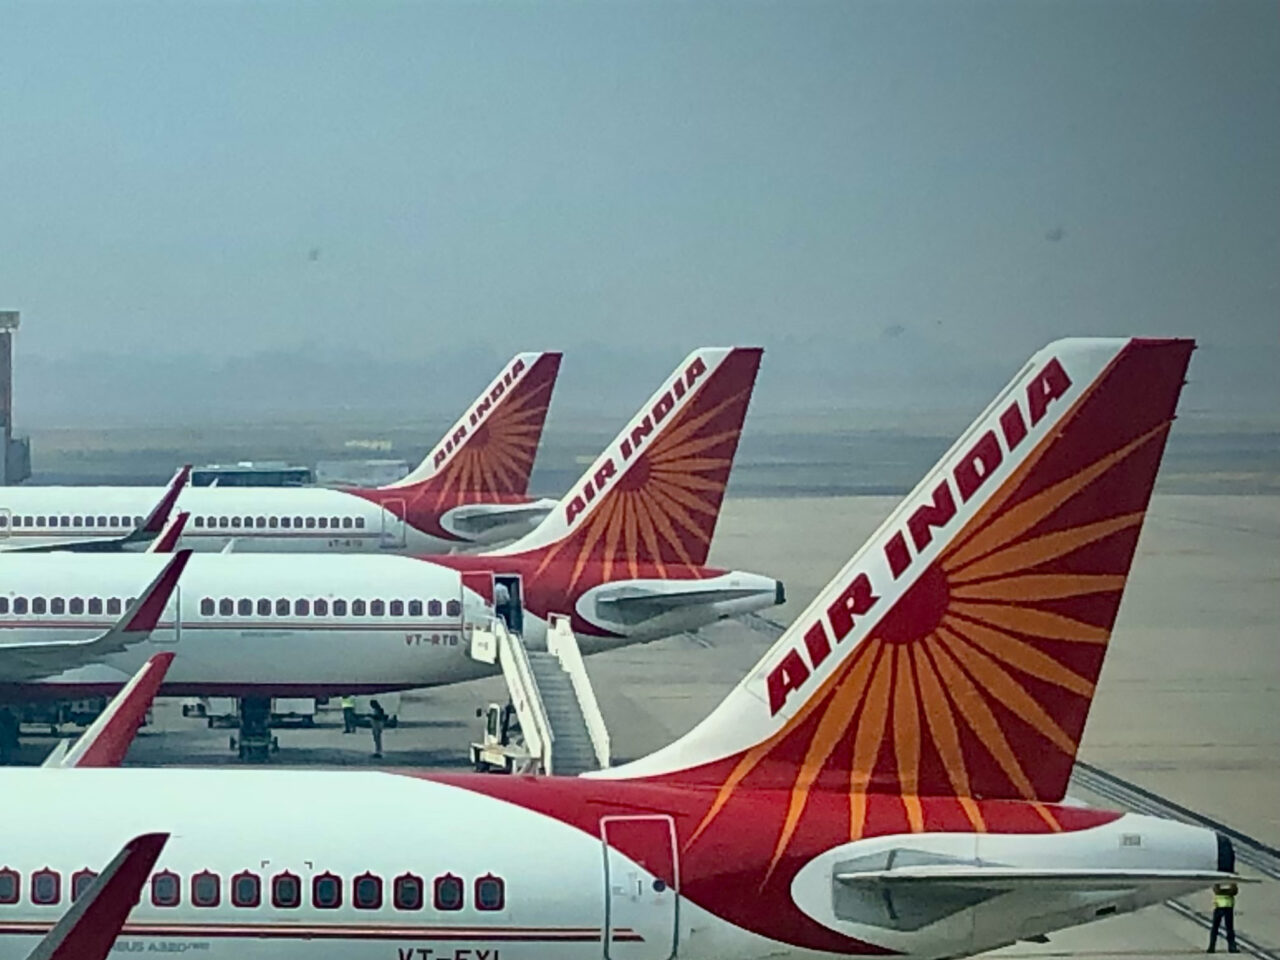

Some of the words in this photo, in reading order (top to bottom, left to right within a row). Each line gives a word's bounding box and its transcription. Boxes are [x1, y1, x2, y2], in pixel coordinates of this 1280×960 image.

[433, 424, 468, 470] AIR
[469, 358, 525, 427] INDIA
[565, 458, 618, 527] AIR
[619, 356, 707, 462] INDIA
[766, 572, 882, 718] AIR
[884, 356, 1073, 581] INDIA
